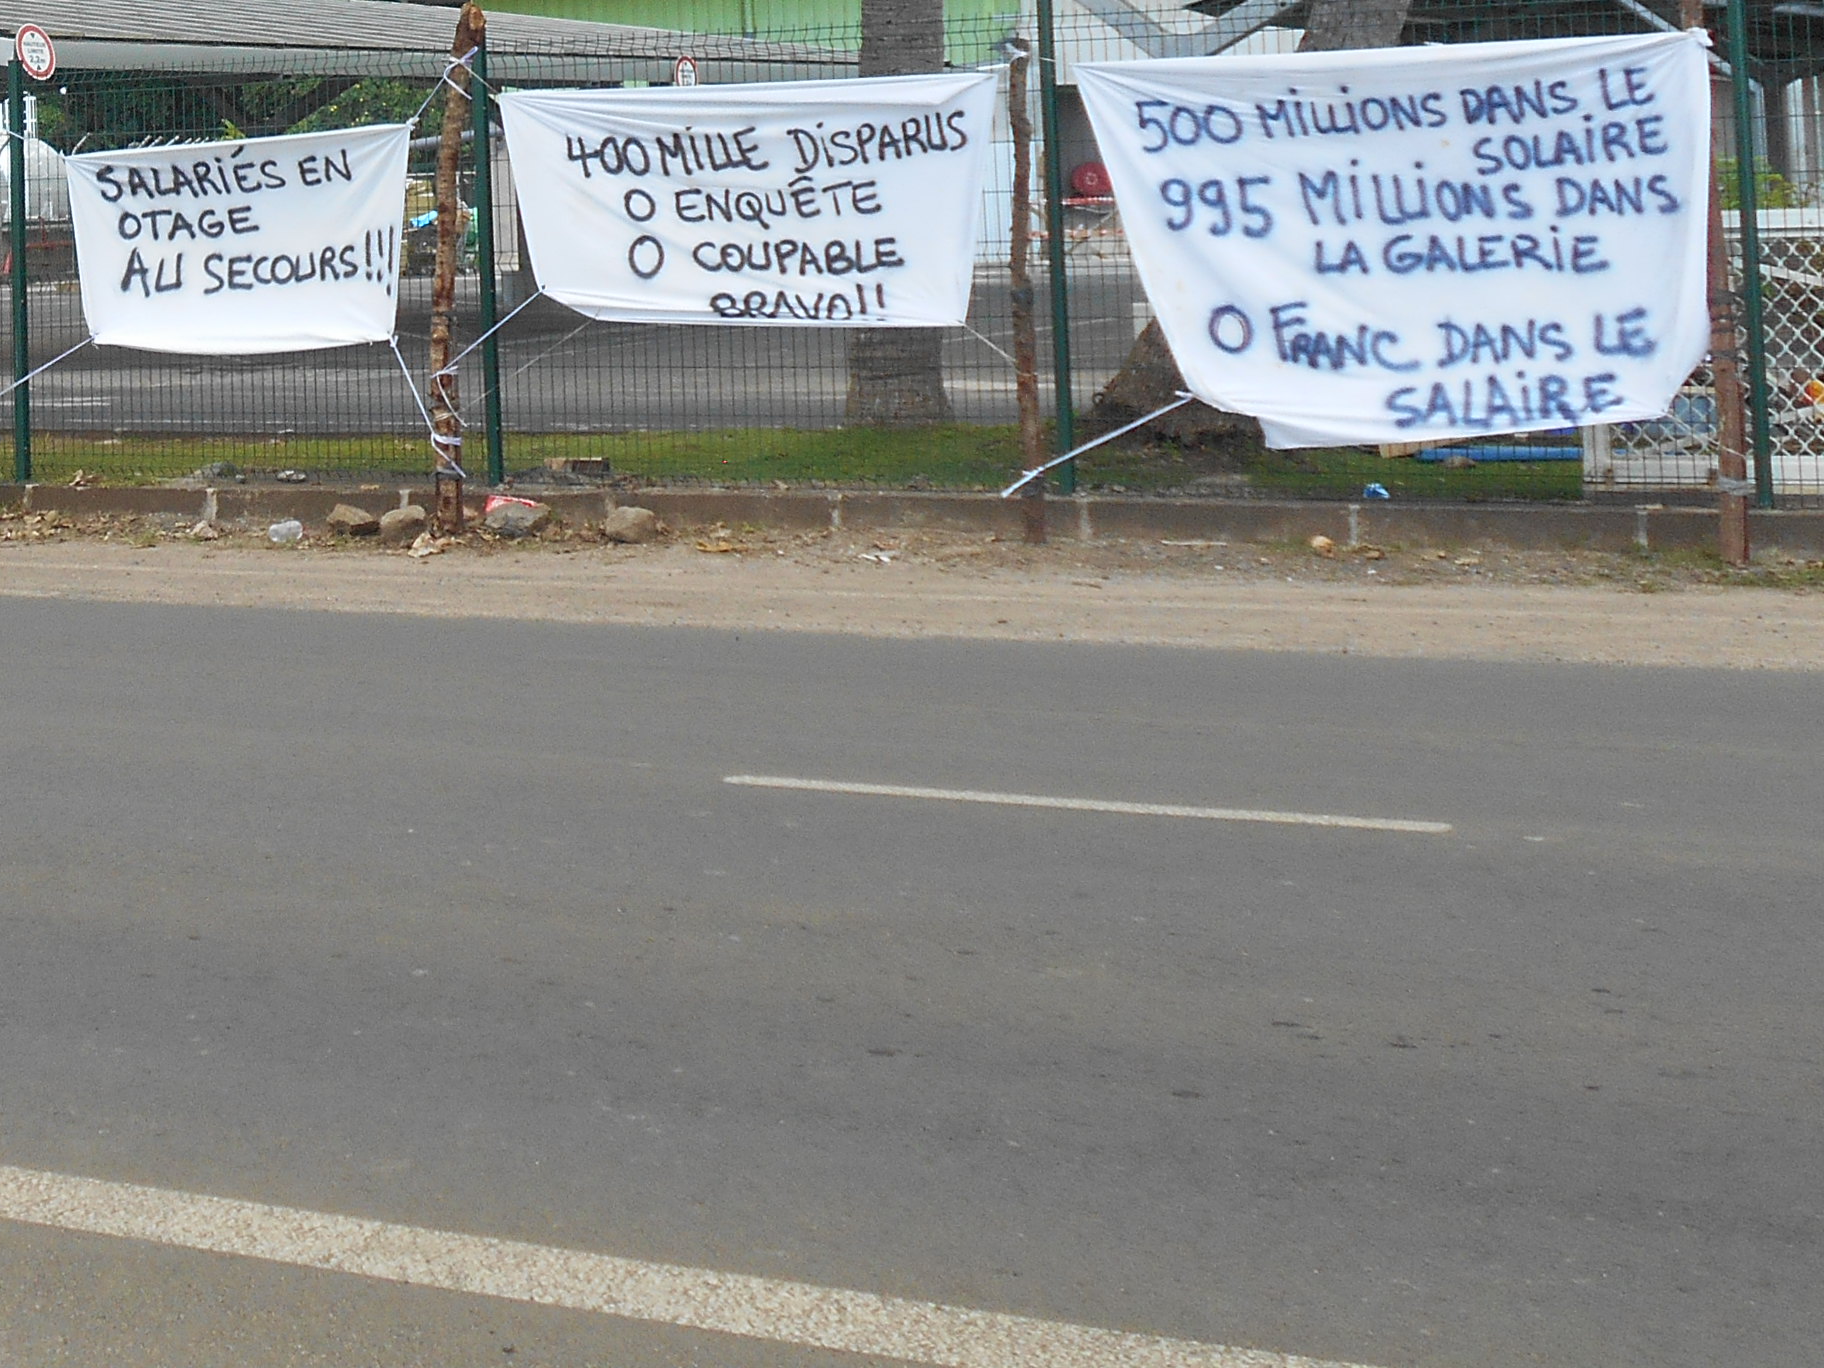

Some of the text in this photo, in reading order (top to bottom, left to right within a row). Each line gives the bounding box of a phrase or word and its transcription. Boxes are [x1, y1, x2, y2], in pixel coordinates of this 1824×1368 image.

[1135, 66, 1656, 154] 500 MILLIONS DANS LE
[566, 110, 970, 178] 400 MILLE DISPARUS
[1472, 114, 1670, 177] SOLAIRE
[95, 145, 353, 203] SALARIÉS EN
[675, 176, 883, 230] ENQUÊTE
[1159, 159, 1682, 238] 995 MILLIONS DANS
[118, 205, 261, 242] OTAGE
[1313, 224, 1611, 276] LA GALERIE
[120, 246, 184, 299] AU
[692, 236, 905, 276] COUPABLE
[1436, 317, 1576, 369] DANS
[1593, 306, 1657, 359] LE
[1383, 369, 1626, 430] SALAIRE
